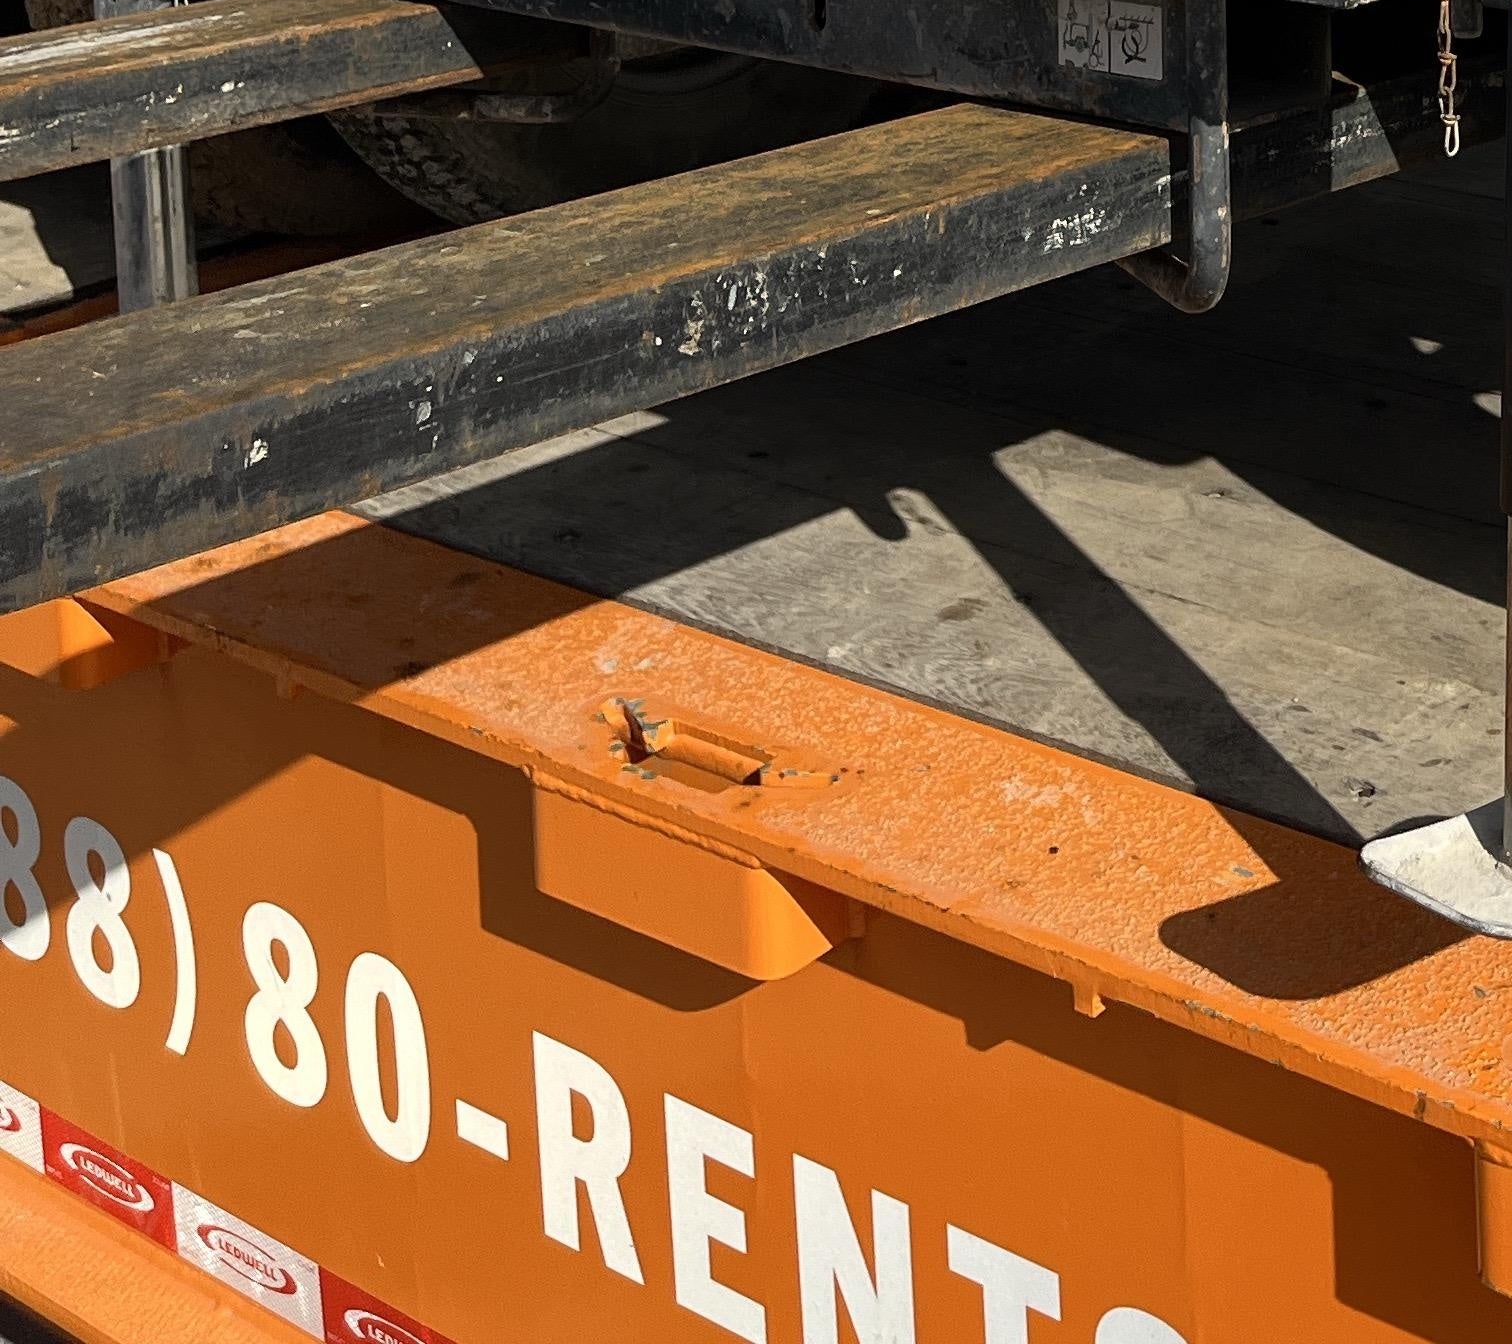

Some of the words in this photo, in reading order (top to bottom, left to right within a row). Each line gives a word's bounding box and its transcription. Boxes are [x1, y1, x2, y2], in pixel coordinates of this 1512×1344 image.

[241, 900, 1192, 1344] 80-RENT
[79, 1155, 137, 1199] LEDWELL
[217, 1236, 278, 1282] LEDWELL
